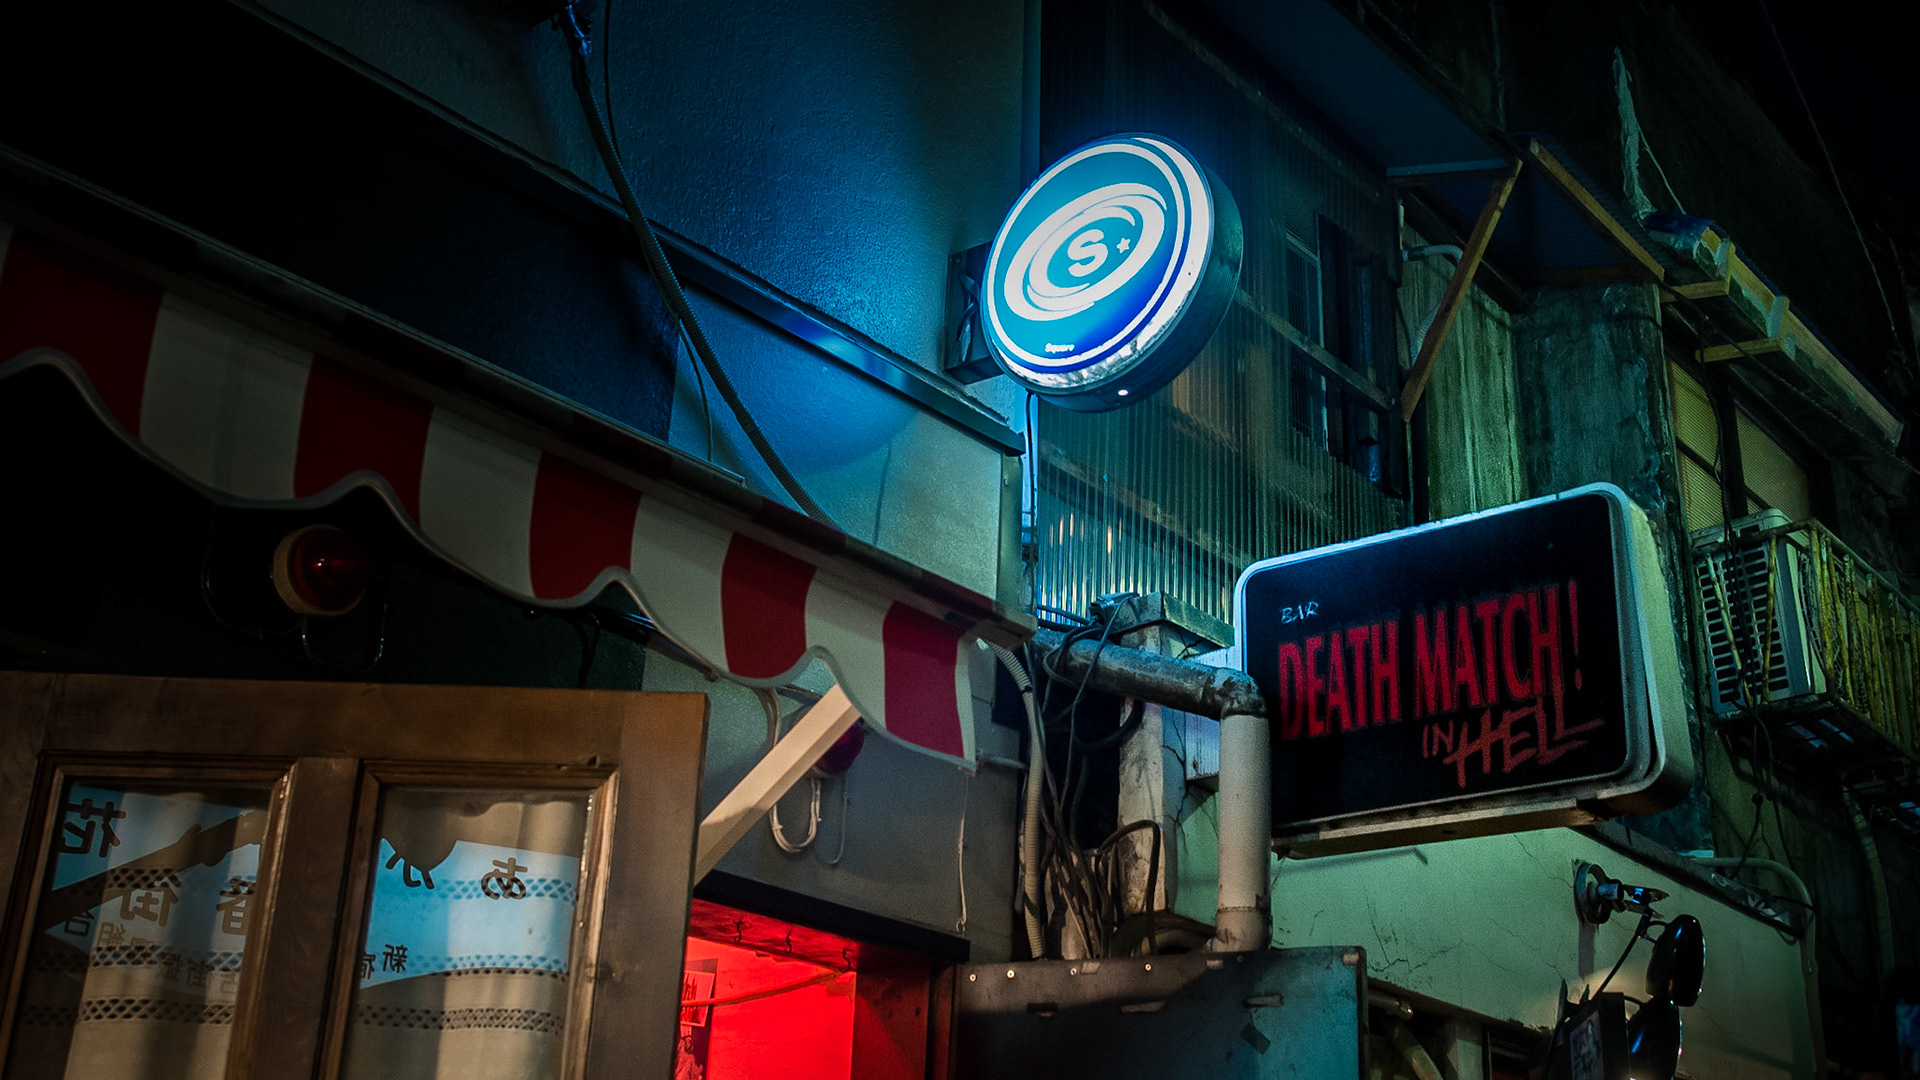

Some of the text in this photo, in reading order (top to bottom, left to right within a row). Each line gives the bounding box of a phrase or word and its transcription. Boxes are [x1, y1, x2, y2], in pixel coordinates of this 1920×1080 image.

[1067, 228, 1108, 278] S
[1281, 601, 1319, 624] BAR
[1278, 617, 1403, 741] DEATH
[1422, 696, 1604, 788] IN HELL
